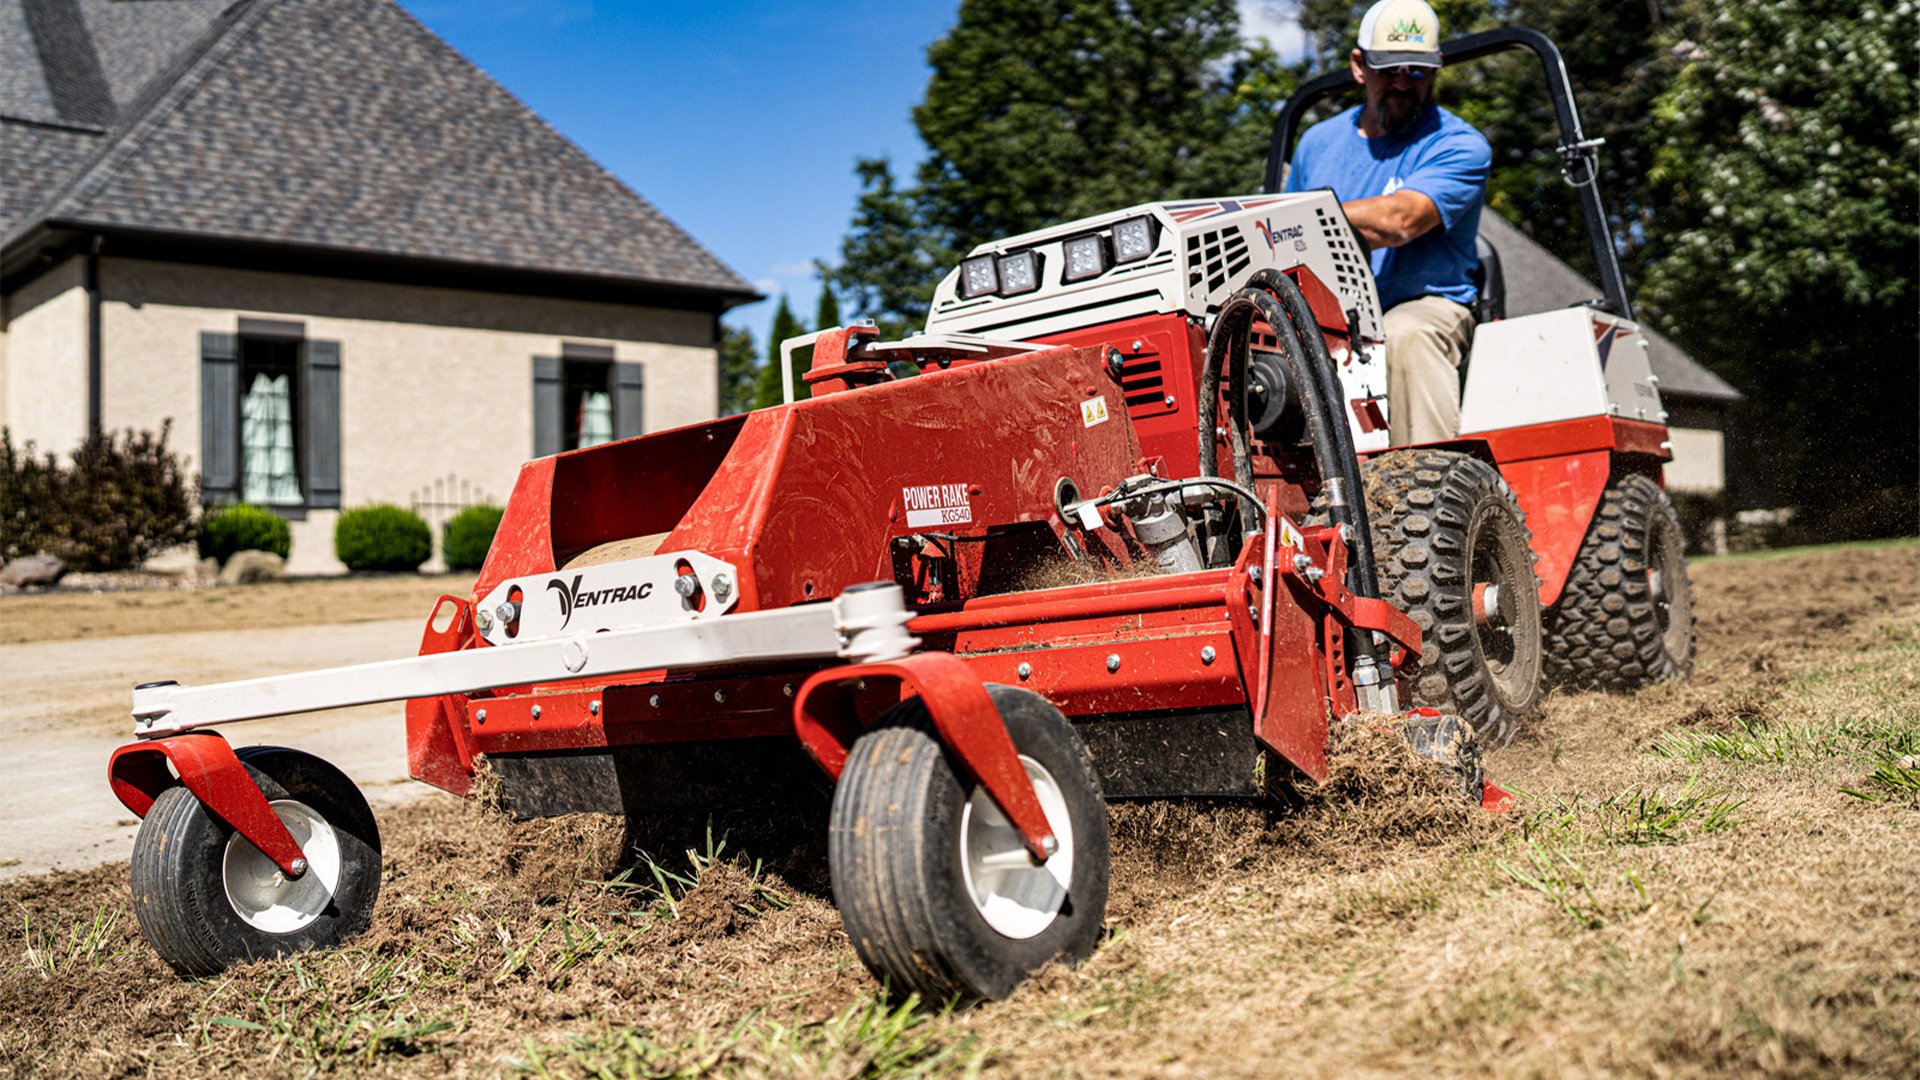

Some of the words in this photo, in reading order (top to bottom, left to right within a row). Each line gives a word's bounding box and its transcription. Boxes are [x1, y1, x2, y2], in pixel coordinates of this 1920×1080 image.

[1255, 217, 1304, 262] VENTRAC
[902, 486, 942, 510] POWER
[941, 484, 970, 507] RAKE
[941, 508, 970, 523] KG540
[546, 574, 654, 631] VENTRAC
